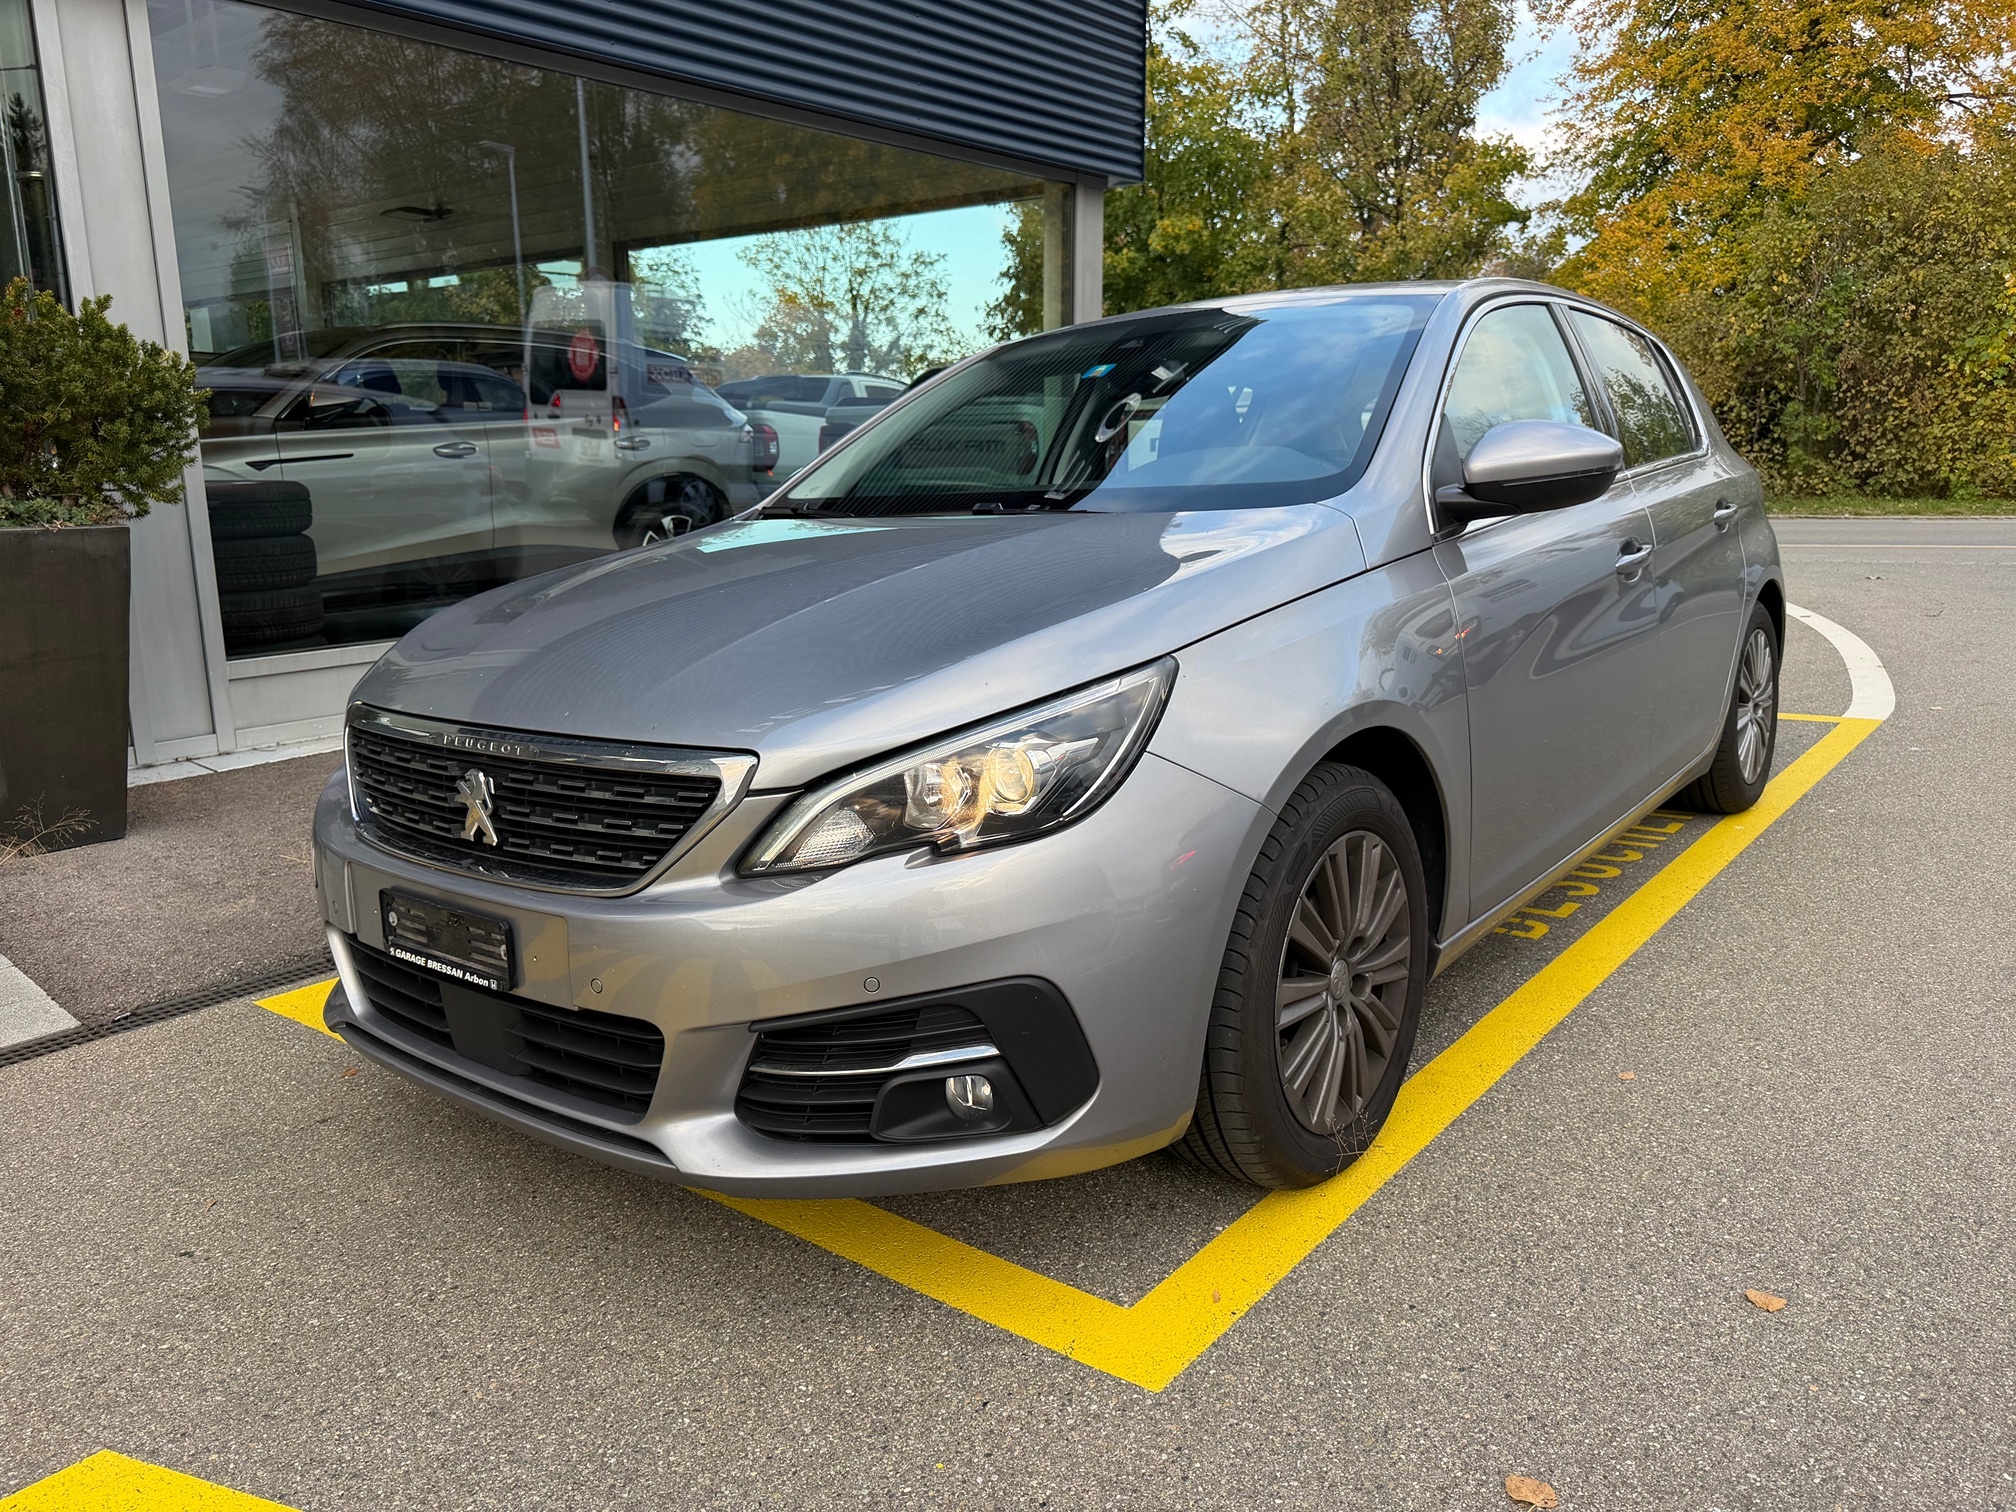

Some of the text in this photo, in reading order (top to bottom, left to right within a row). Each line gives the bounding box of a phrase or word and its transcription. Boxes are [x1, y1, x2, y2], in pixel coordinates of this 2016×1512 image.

[443, 734, 524, 756] PEUGEOT
[395, 949, 426, 966] GARAGE
[427, 960, 464, 979] BRESSAN
[464, 972, 489, 987] Arbon
